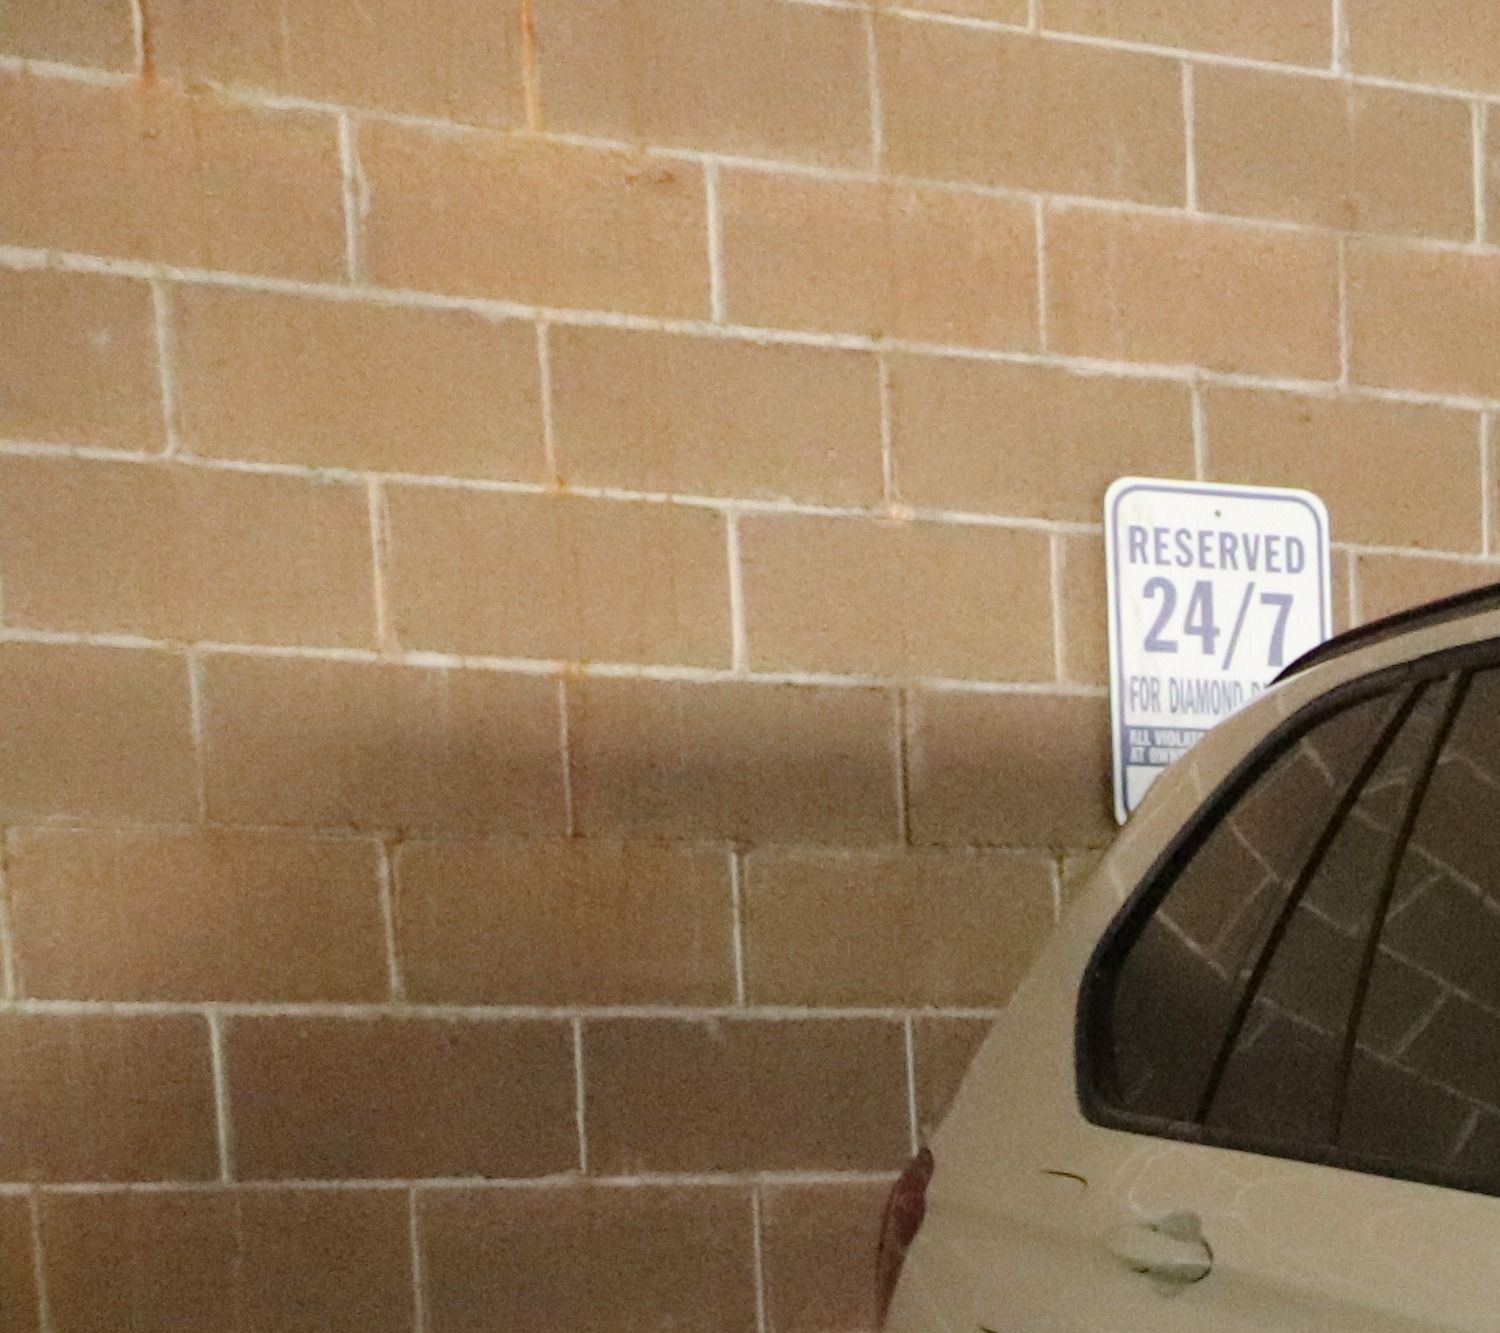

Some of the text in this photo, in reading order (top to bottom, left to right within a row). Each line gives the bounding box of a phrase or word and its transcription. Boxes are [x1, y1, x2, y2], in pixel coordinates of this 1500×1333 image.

[1128, 525, 1305, 574] RESERVED
[1142, 576, 1294, 670] 24/7
[1130, 675, 1161, 713] FOR
[1169, 677, 1243, 715] DIAMOND
